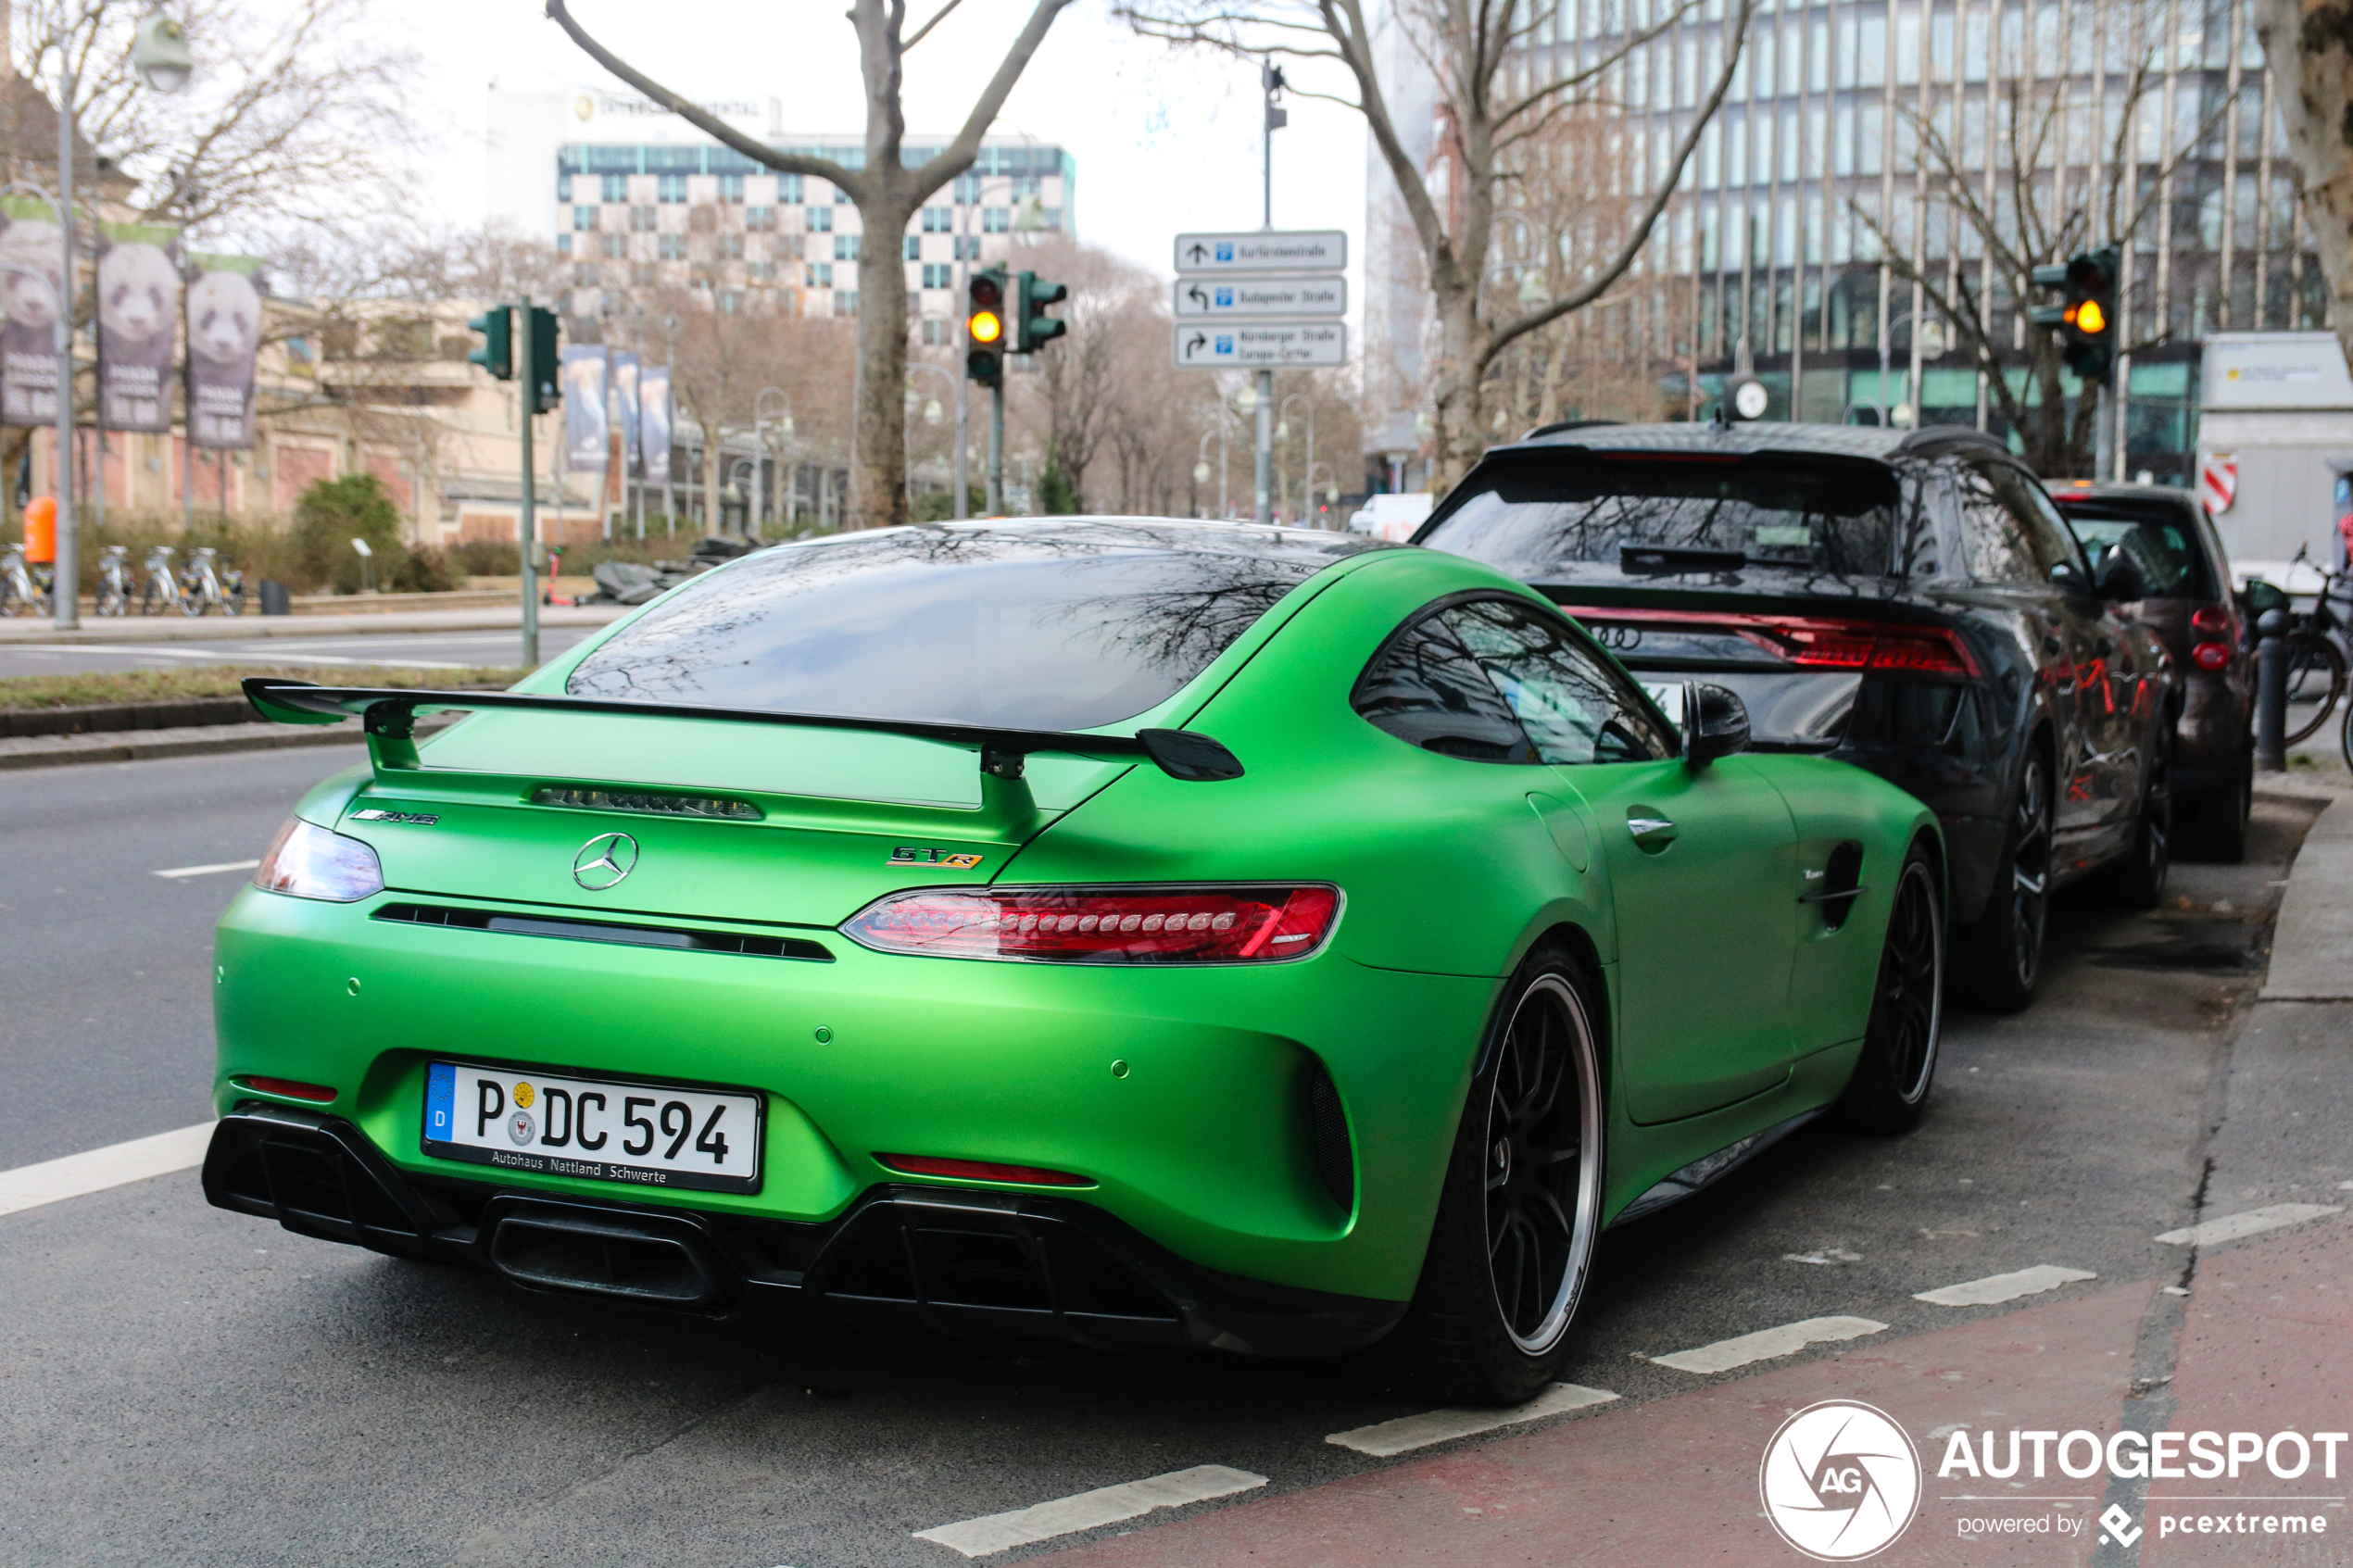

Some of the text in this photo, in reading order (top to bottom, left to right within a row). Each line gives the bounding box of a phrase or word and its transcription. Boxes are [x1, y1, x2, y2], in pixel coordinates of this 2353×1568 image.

[1302, 288, 1335, 303] Straße
[1302, 329, 1335, 342] Straße
[434, 1110, 446, 1127] D
[477, 1078, 505, 1137] P
[541, 1086, 608, 1150] DC
[623, 1096, 729, 1164] 594
[492, 1150, 666, 1184] Autohaus Nattland Schwerte
